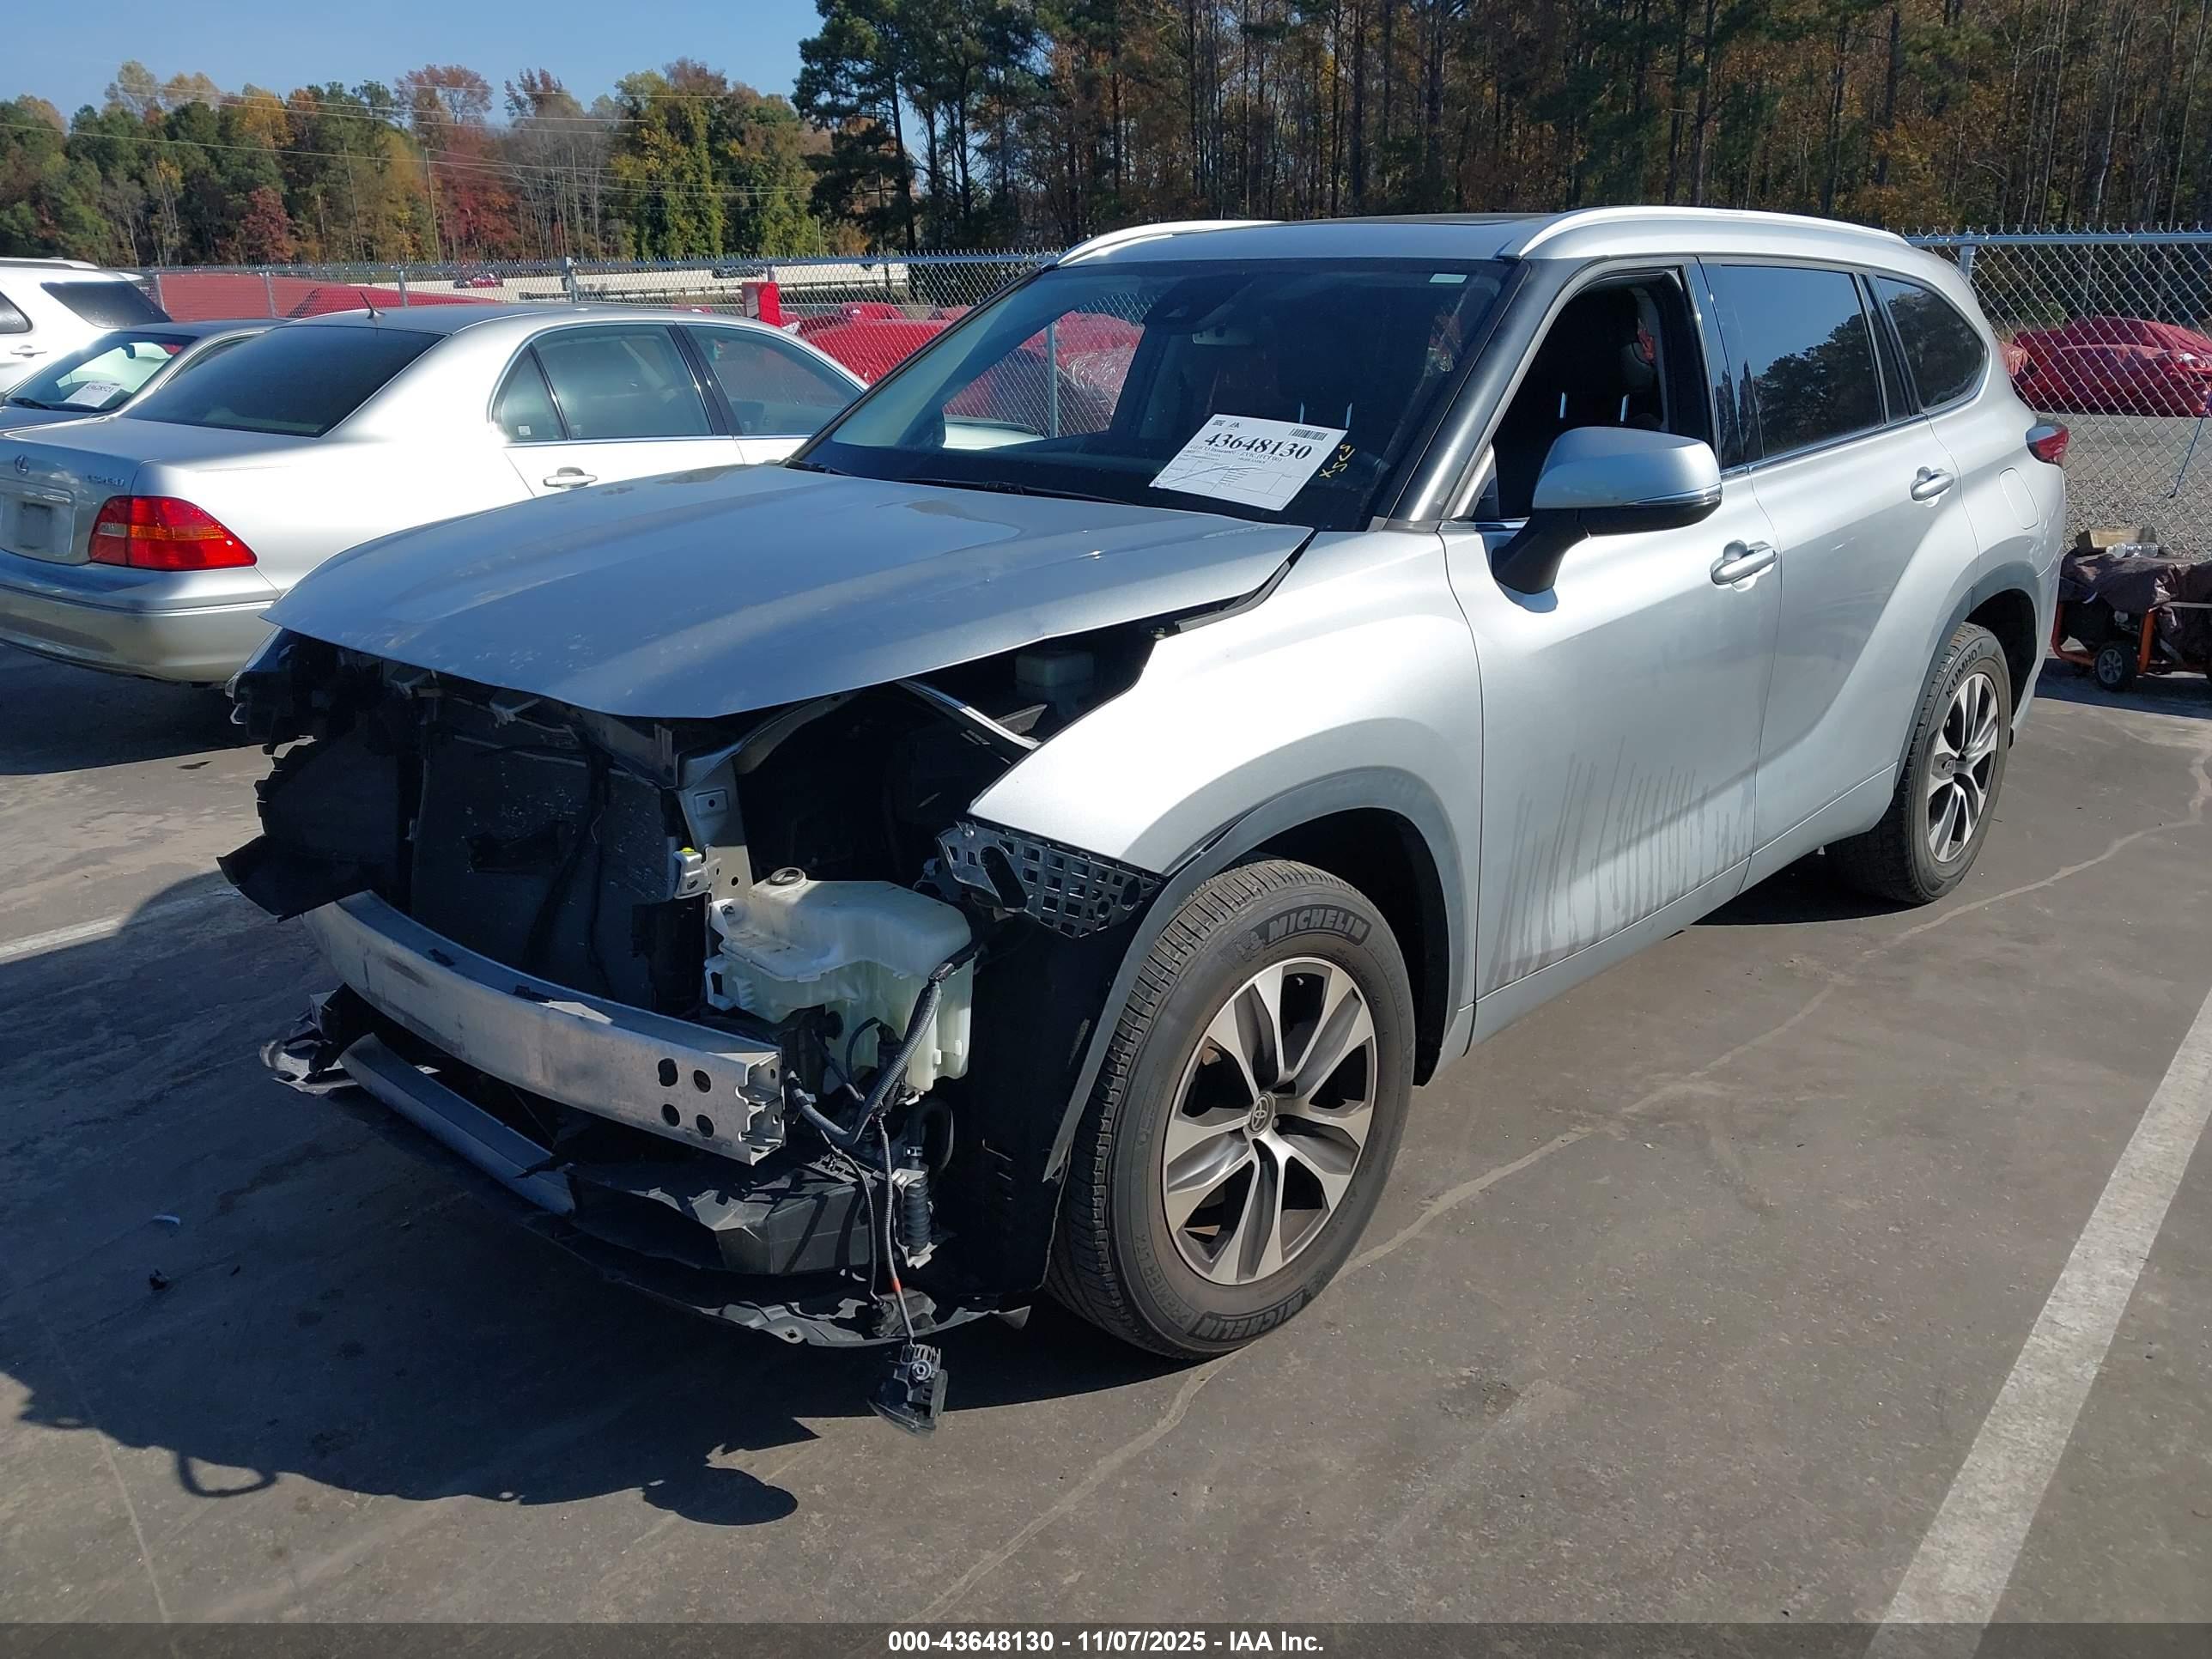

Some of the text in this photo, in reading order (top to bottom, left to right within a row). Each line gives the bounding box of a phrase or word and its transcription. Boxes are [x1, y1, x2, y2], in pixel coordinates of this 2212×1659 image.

[1205, 432, 1313, 460] 43648130
[1945, 649, 1978, 698] KUMHO
[1267, 908, 1369, 941] MICHELIN
[1194, 1291, 1304, 1340] MICHELIN
